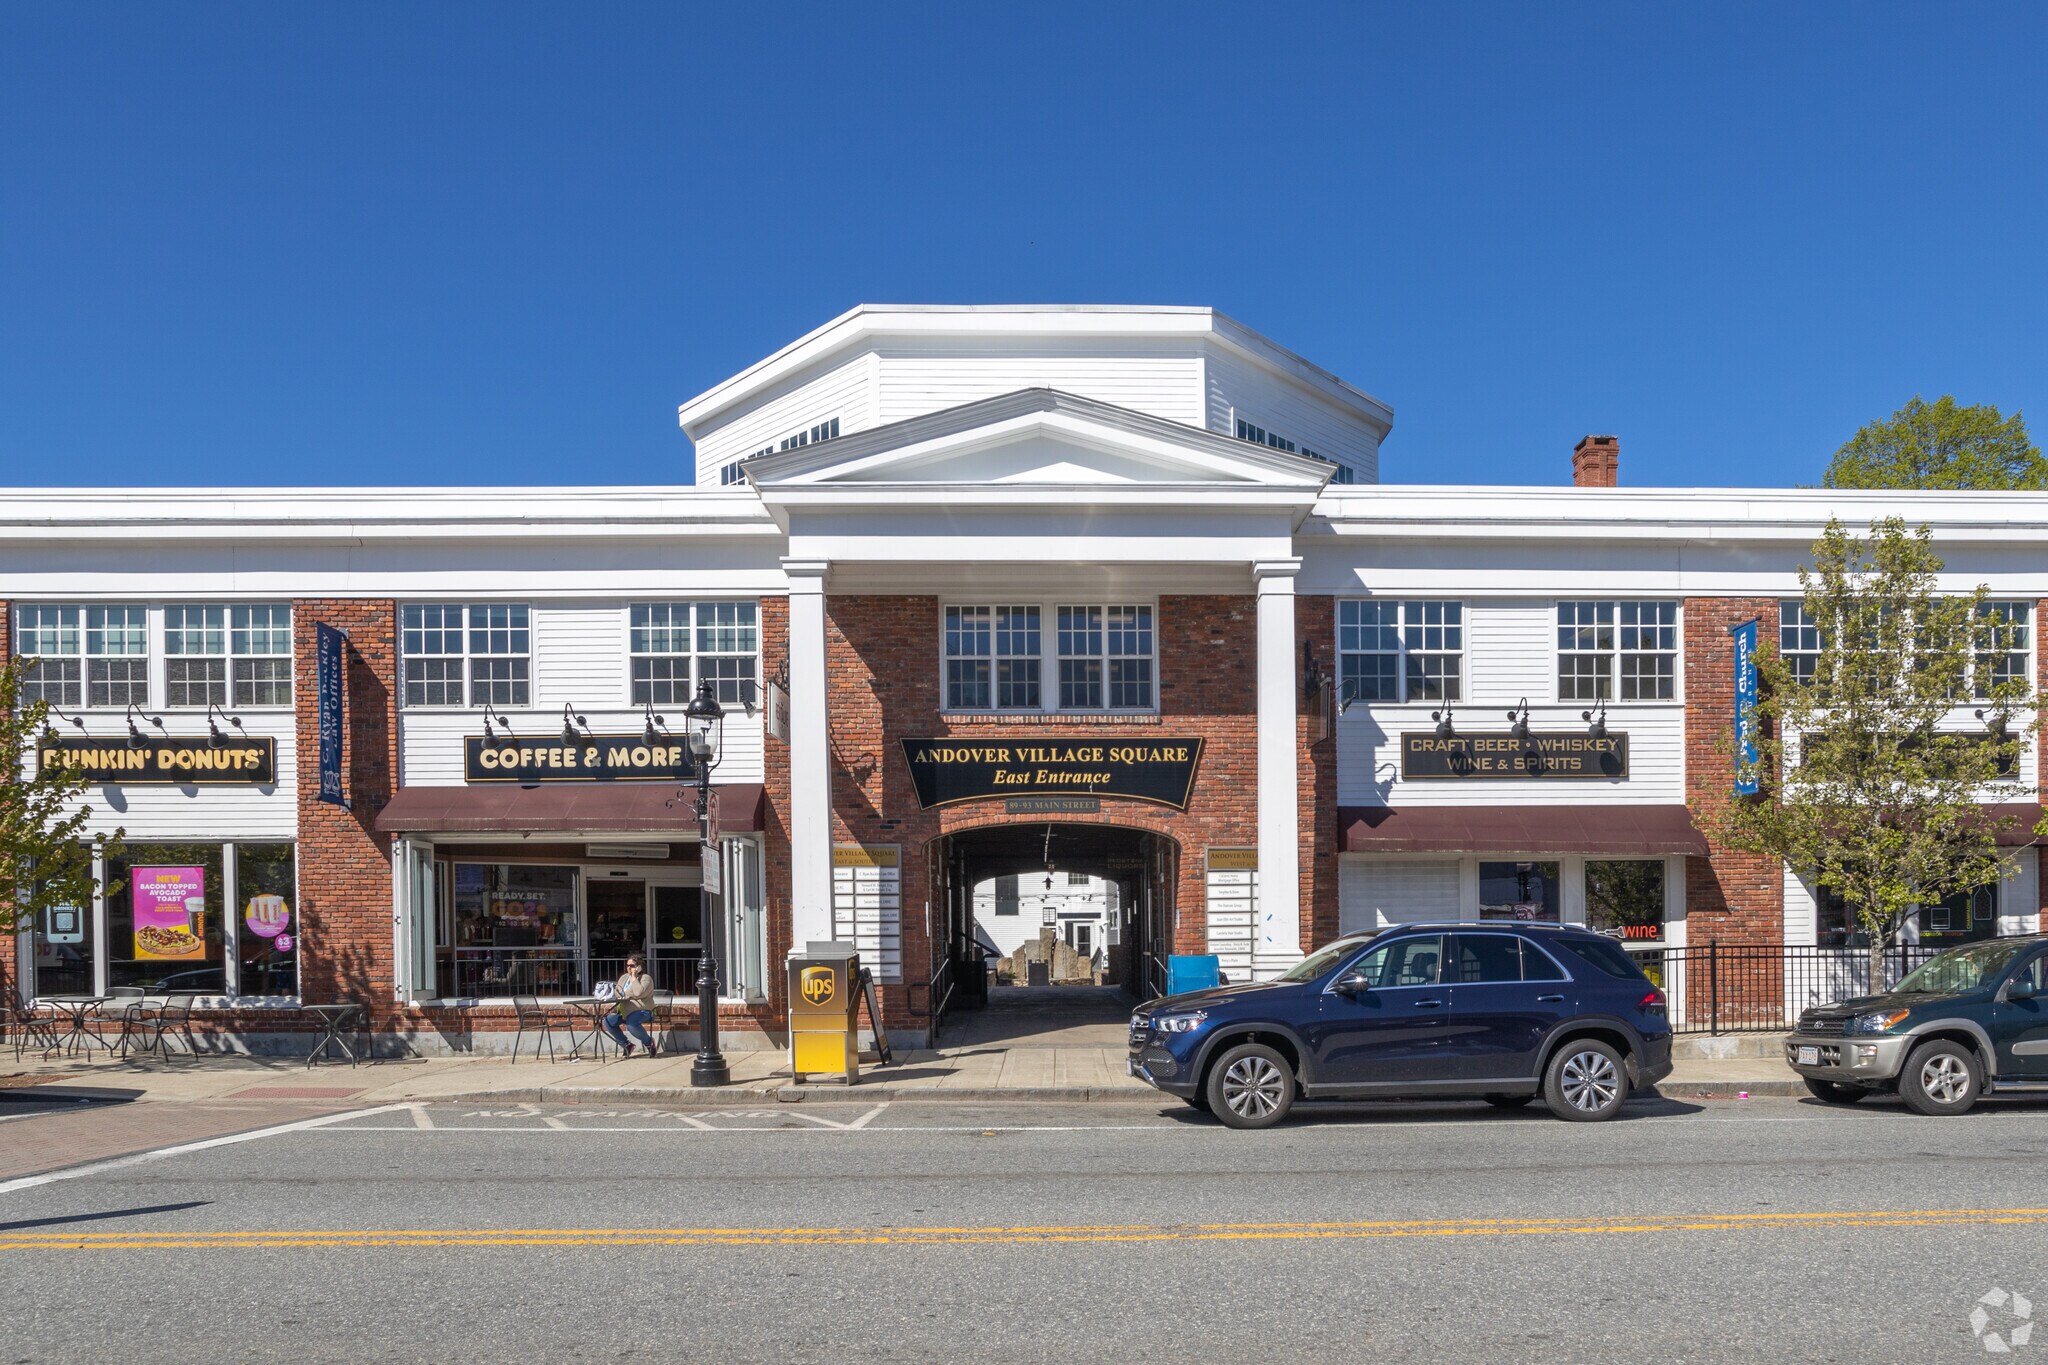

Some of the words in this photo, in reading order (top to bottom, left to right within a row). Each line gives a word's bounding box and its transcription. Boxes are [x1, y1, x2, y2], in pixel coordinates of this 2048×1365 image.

[1738, 631, 1747, 693] Church
[330, 655, 338, 710] Offices
[321, 701, 331, 741] Ryan
[1410, 739, 1469, 751] CRAFT
[1474, 739, 1520, 751] BEER
[1537, 739, 1619, 751] WHISKEY
[479, 747, 577, 769] COFFEE
[583, 747, 602, 768] &
[607, 746, 682, 768] MORE
[914, 748, 1011, 763] ANDOVER
[1016, 747, 1104, 762] VILLAGE
[1109, 747, 1189, 765] SQUARE
[1447, 757, 1493, 770] WINE
[1498, 758, 1509, 770] &
[1514, 757, 1582, 770] SPIRITS
[993, 770, 1030, 784] East
[1035, 770, 1111, 784] Entrance
[1009, 801, 1032, 809] 89-93
[1035, 801, 1060, 809] MAIN
[1062, 801, 1096, 809] STREET
[156, 874, 181, 883] NEW
[491, 891, 525, 900] READY.
[526, 891, 546, 900] SET.
[1623, 925, 1657, 938] wine
[277, 936, 290, 946] $3
[804, 979, 832, 1000] ups
